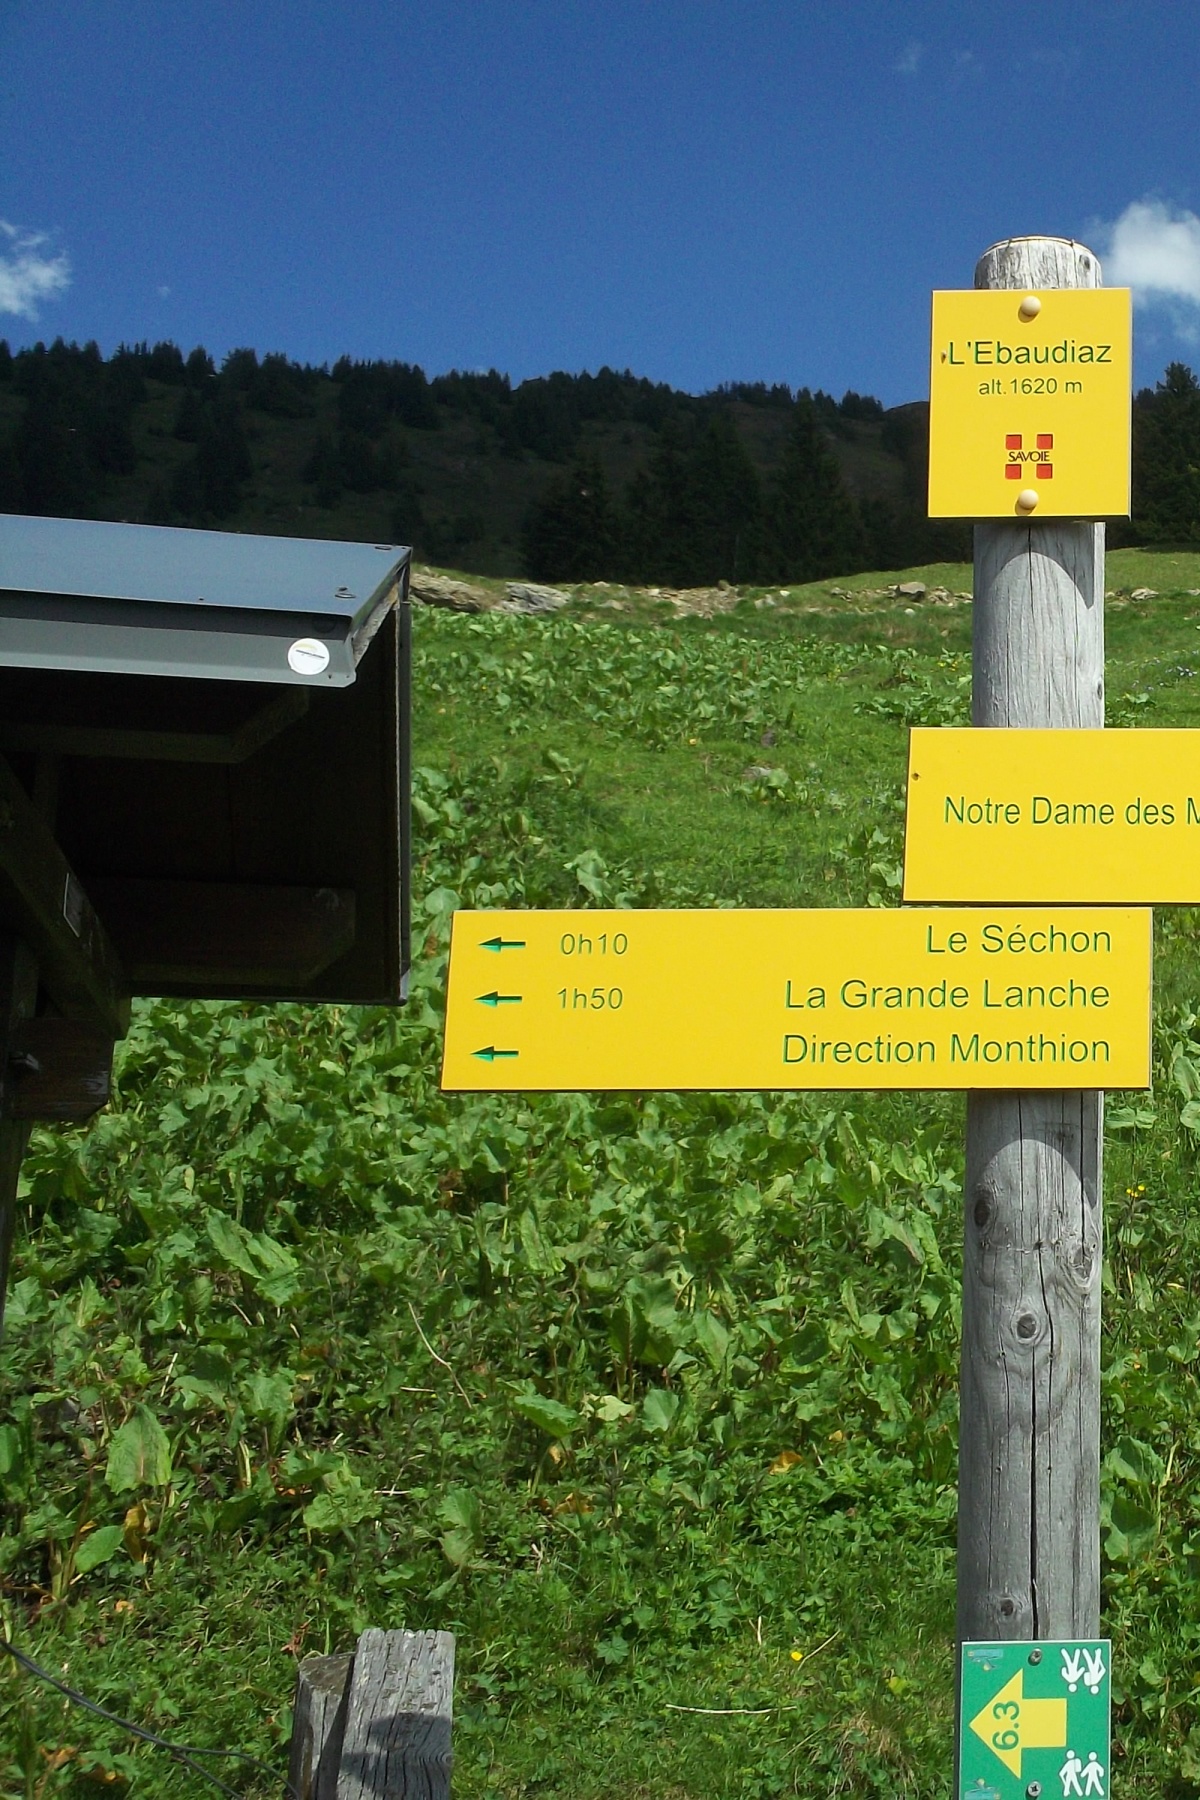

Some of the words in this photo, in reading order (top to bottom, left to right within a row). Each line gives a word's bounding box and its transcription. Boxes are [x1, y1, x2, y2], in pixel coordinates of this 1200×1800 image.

[950, 340, 1111, 364] L'Ebaudiaz
[1066, 382, 1082, 393] m
[1009, 451, 1049, 462] SAVOIE
[946, 797, 1020, 824] Notre
[1033, 797, 1114, 824] Dame
[1126, 798, 1174, 825] des
[561, 933, 627, 955] 0h10
[928, 925, 967, 953] Le
[982, 925, 1110, 953] Séchon
[558, 988, 622, 1009] 1h50
[786, 981, 825, 1008] La
[841, 980, 968, 1008] Grande
[984, 979, 1109, 1007] Lanche
[784, 1035, 935, 1063] Direction
[951, 1034, 1109, 1062] Monthion
[992, 1701, 1019, 1750] 6.3
